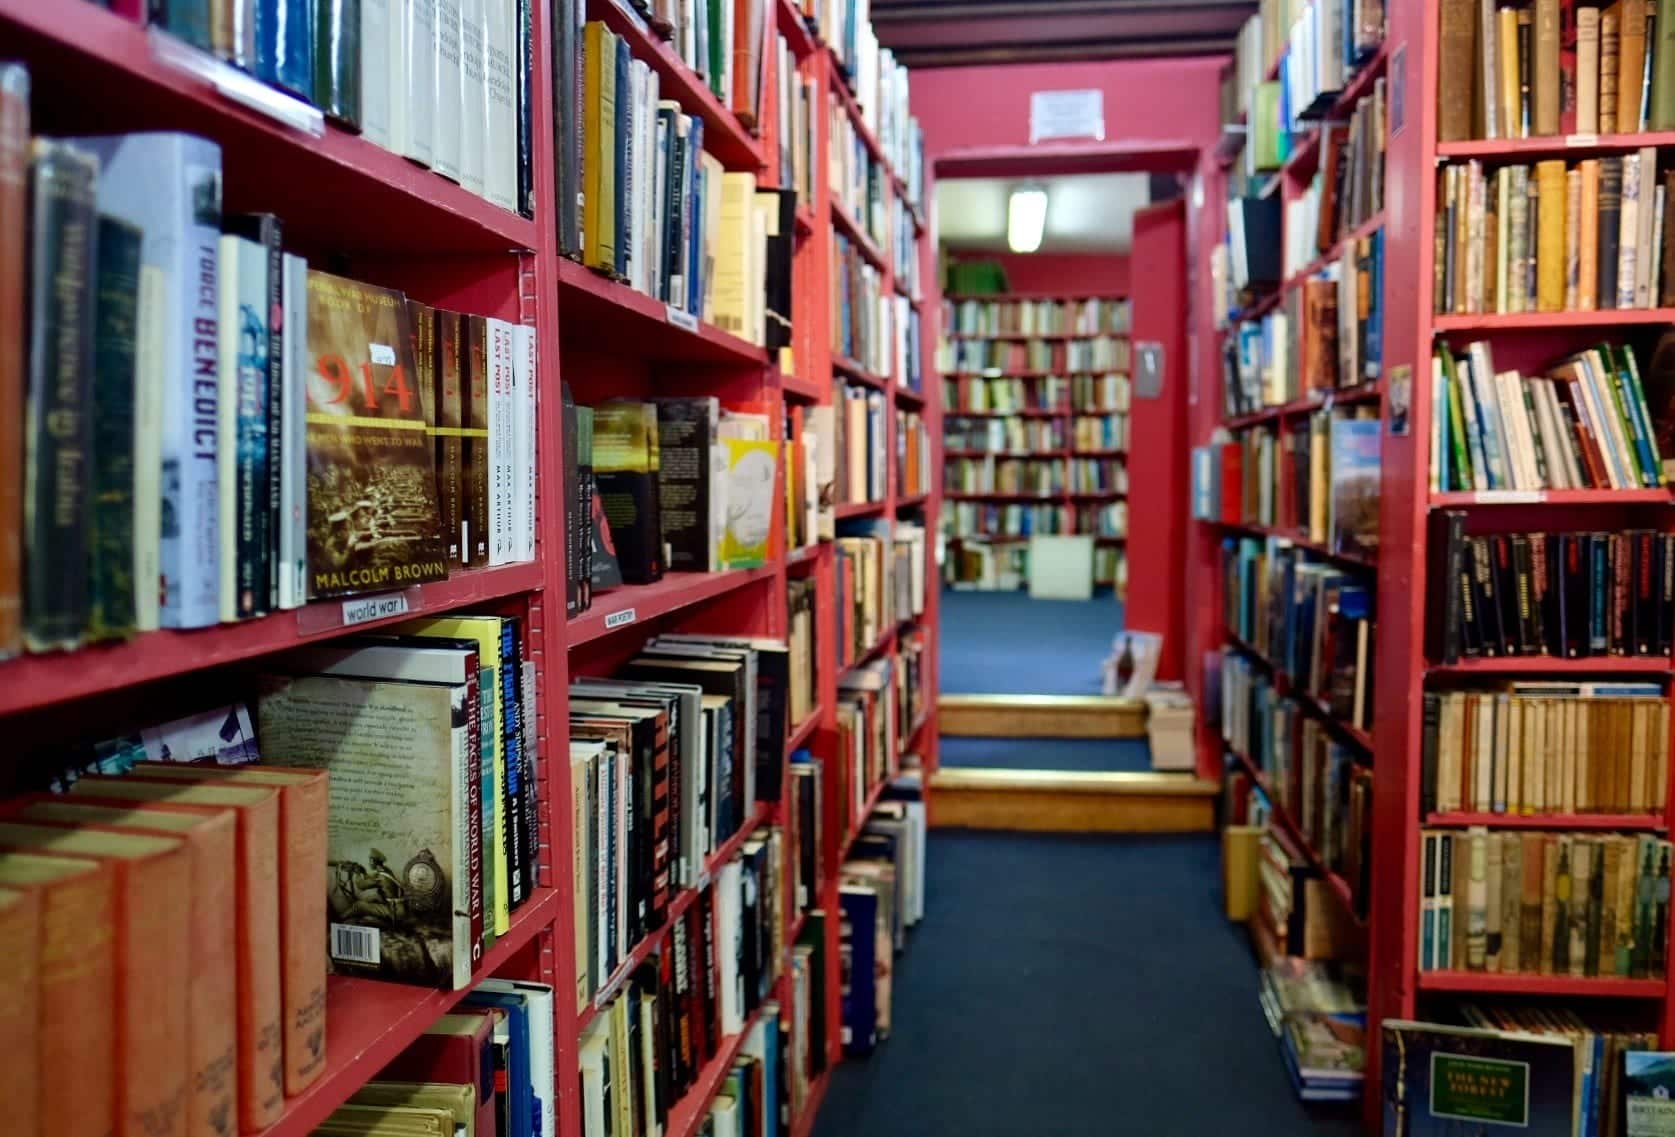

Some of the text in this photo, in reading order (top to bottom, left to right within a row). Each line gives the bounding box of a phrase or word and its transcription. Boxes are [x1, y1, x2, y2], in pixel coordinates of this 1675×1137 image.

[193, 317, 219, 461] BENEDICT
[307, 351, 414, 412] 914
[316, 561, 445, 590] MALCOLM BROWN
[346, 602, 377, 621] world
[379, 601, 399, 615] war
[501, 624, 513, 658] THE
[467, 696, 477, 731] THE
[503, 663, 516, 735] FIGHTING
[468, 734, 478, 782] FACES
[513, 702, 523, 774] ANDY SIMPSON
[507, 738, 519, 796] NATION
[469, 784, 479, 808] OF
[470, 809, 480, 871] WORLD
[471, 873, 481, 912] WAR
